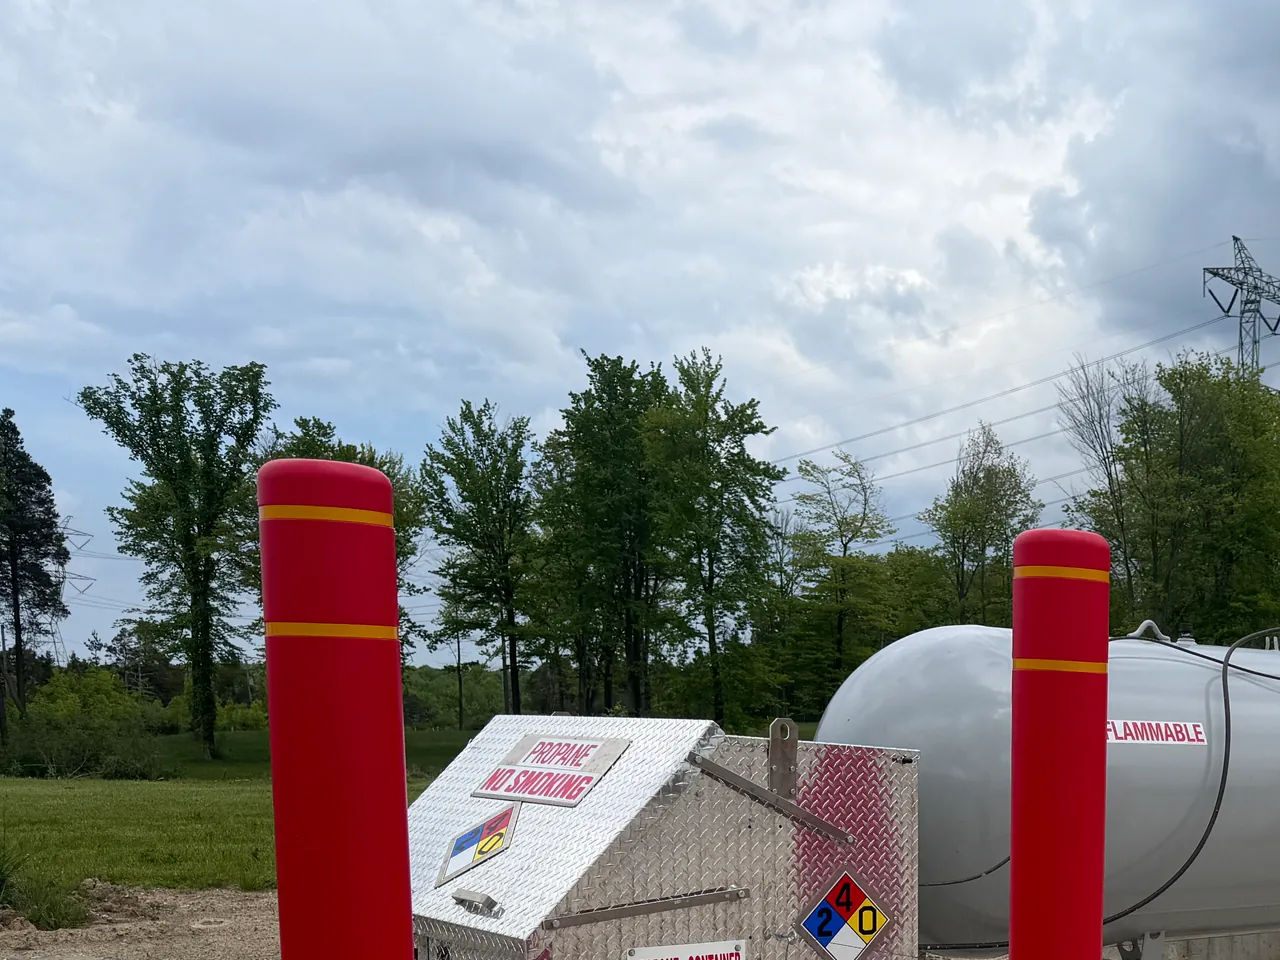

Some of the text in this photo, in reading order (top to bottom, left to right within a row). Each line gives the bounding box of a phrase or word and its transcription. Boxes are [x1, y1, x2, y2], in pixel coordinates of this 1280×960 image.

[523, 742, 598, 767] PROPANE
[479, 768, 595, 800] NO SMOKING
[486, 812, 509, 835] 4
[455, 829, 480, 851] 2
[478, 832, 504, 855] 0
[835, 882, 853, 912] 4
[817, 907, 832, 937] 2
[858, 906, 877, 935] 0
